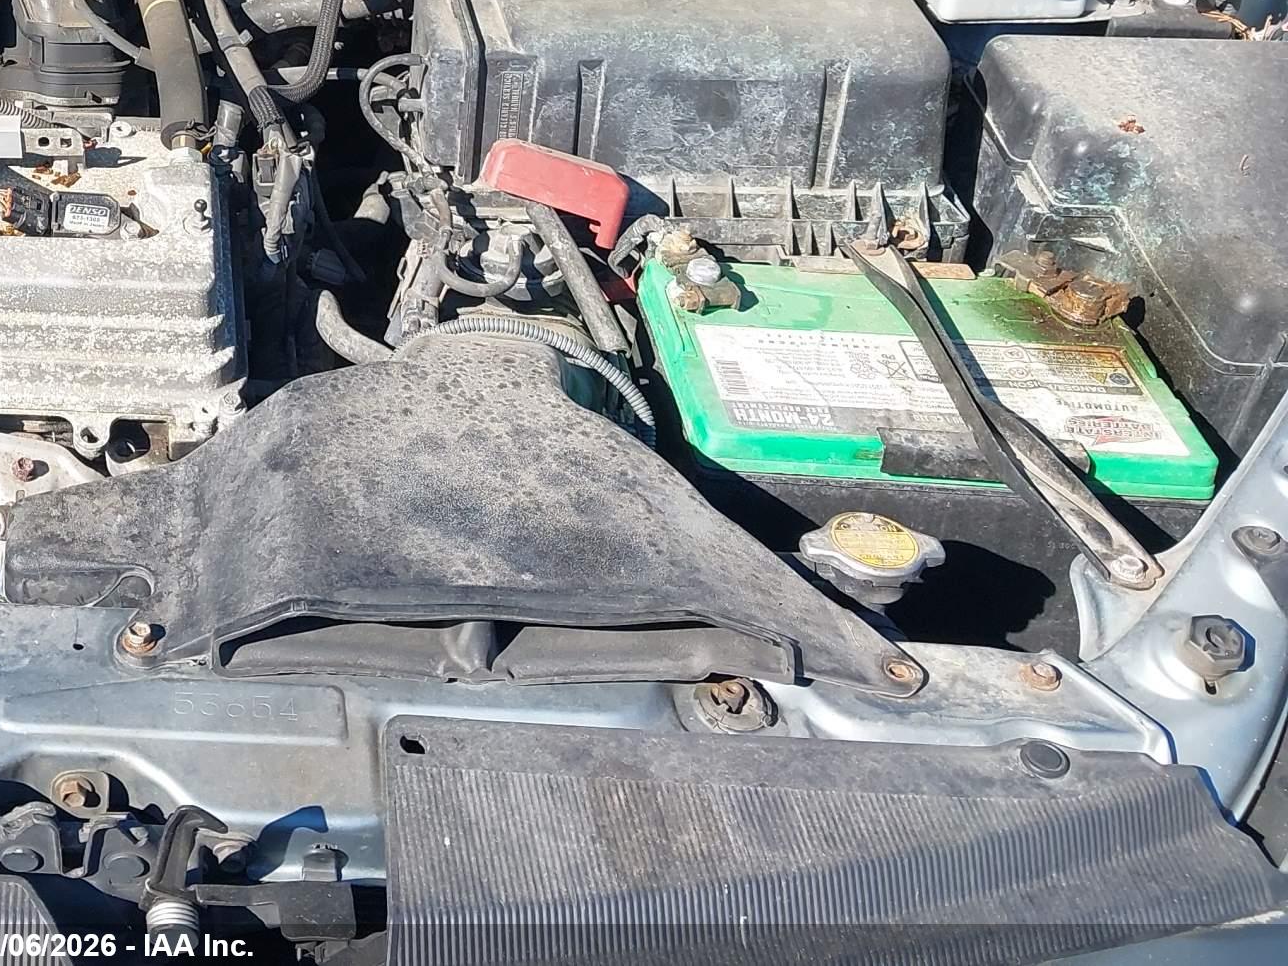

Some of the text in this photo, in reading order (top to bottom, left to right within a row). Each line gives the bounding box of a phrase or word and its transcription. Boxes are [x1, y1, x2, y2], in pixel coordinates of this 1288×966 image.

[69, 205, 107, 217] DENSO
[732, 408, 835, 427] 24-MONTH
[1068, 418, 1153, 431] BATTERIES
[1064, 425, 1161, 440] INTERSTATE
